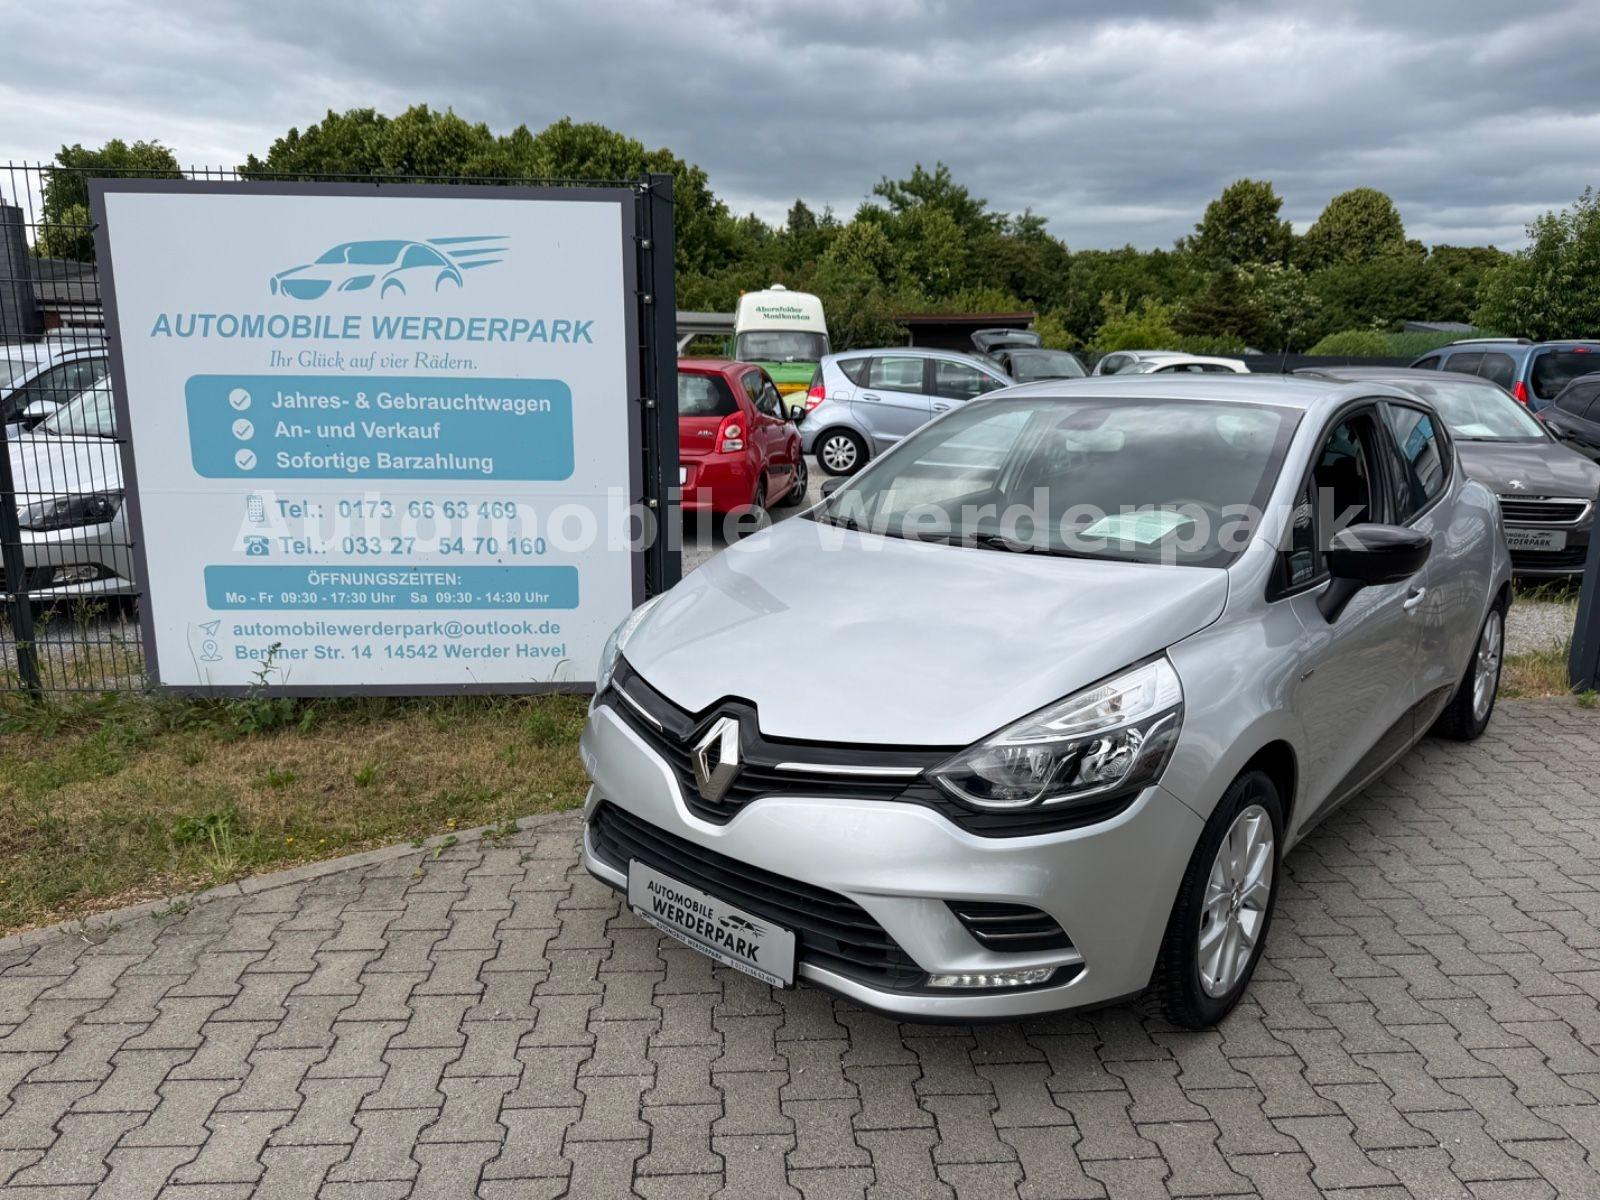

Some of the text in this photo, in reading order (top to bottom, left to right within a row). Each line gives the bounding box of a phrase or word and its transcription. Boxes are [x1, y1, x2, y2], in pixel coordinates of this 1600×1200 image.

[150, 313, 595, 345] AUTOMOBILE WERDERPARK
[269, 350, 478, 371] Ihr Glück auf vier Rädern.
[271, 391, 552, 417] Jahres- & Gebrauchtwagen
[274, 421, 441, 440] An- und Verkauf
[276, 450, 494, 474] Sofortige Barzahlung
[338, 501, 393, 520] 0173
[407, 501, 436, 520] 66
[442, 501, 470, 520] 63
[476, 501, 518, 520] 469
[341, 537, 382, 556] 033
[389, 537, 415, 556] 27
[438, 537, 466, 556] 54
[472, 537, 500, 555] 70
[507, 536, 547, 555] 160
[307, 571, 462, 587] ÖFFNUNGSZEITEN:
[225, 593, 248, 604] Mo
[259, 593, 274, 604] Fr
[281, 593, 319, 604] 09:30
[330, 593, 369, 604] 17:30
[371, 592, 396, 604] Uhr
[410, 592, 428, 603] Sa
[436, 592, 474, 604] 09:30
[484, 592, 522, 603] 14:30
[525, 592, 550, 603] Uhr
[232, 620, 561, 641] automobilewerderpark@outlook.de
[314, 645, 346, 660] Str.
[351, 645, 373, 660] 14
[383, 645, 438, 660] 14542
[444, 644, 511, 660] Werder
[516, 643, 567, 659] Havel
[647, 880, 714, 919] AUTOMOBILE
[651, 896, 760, 963] WERDERPARK
